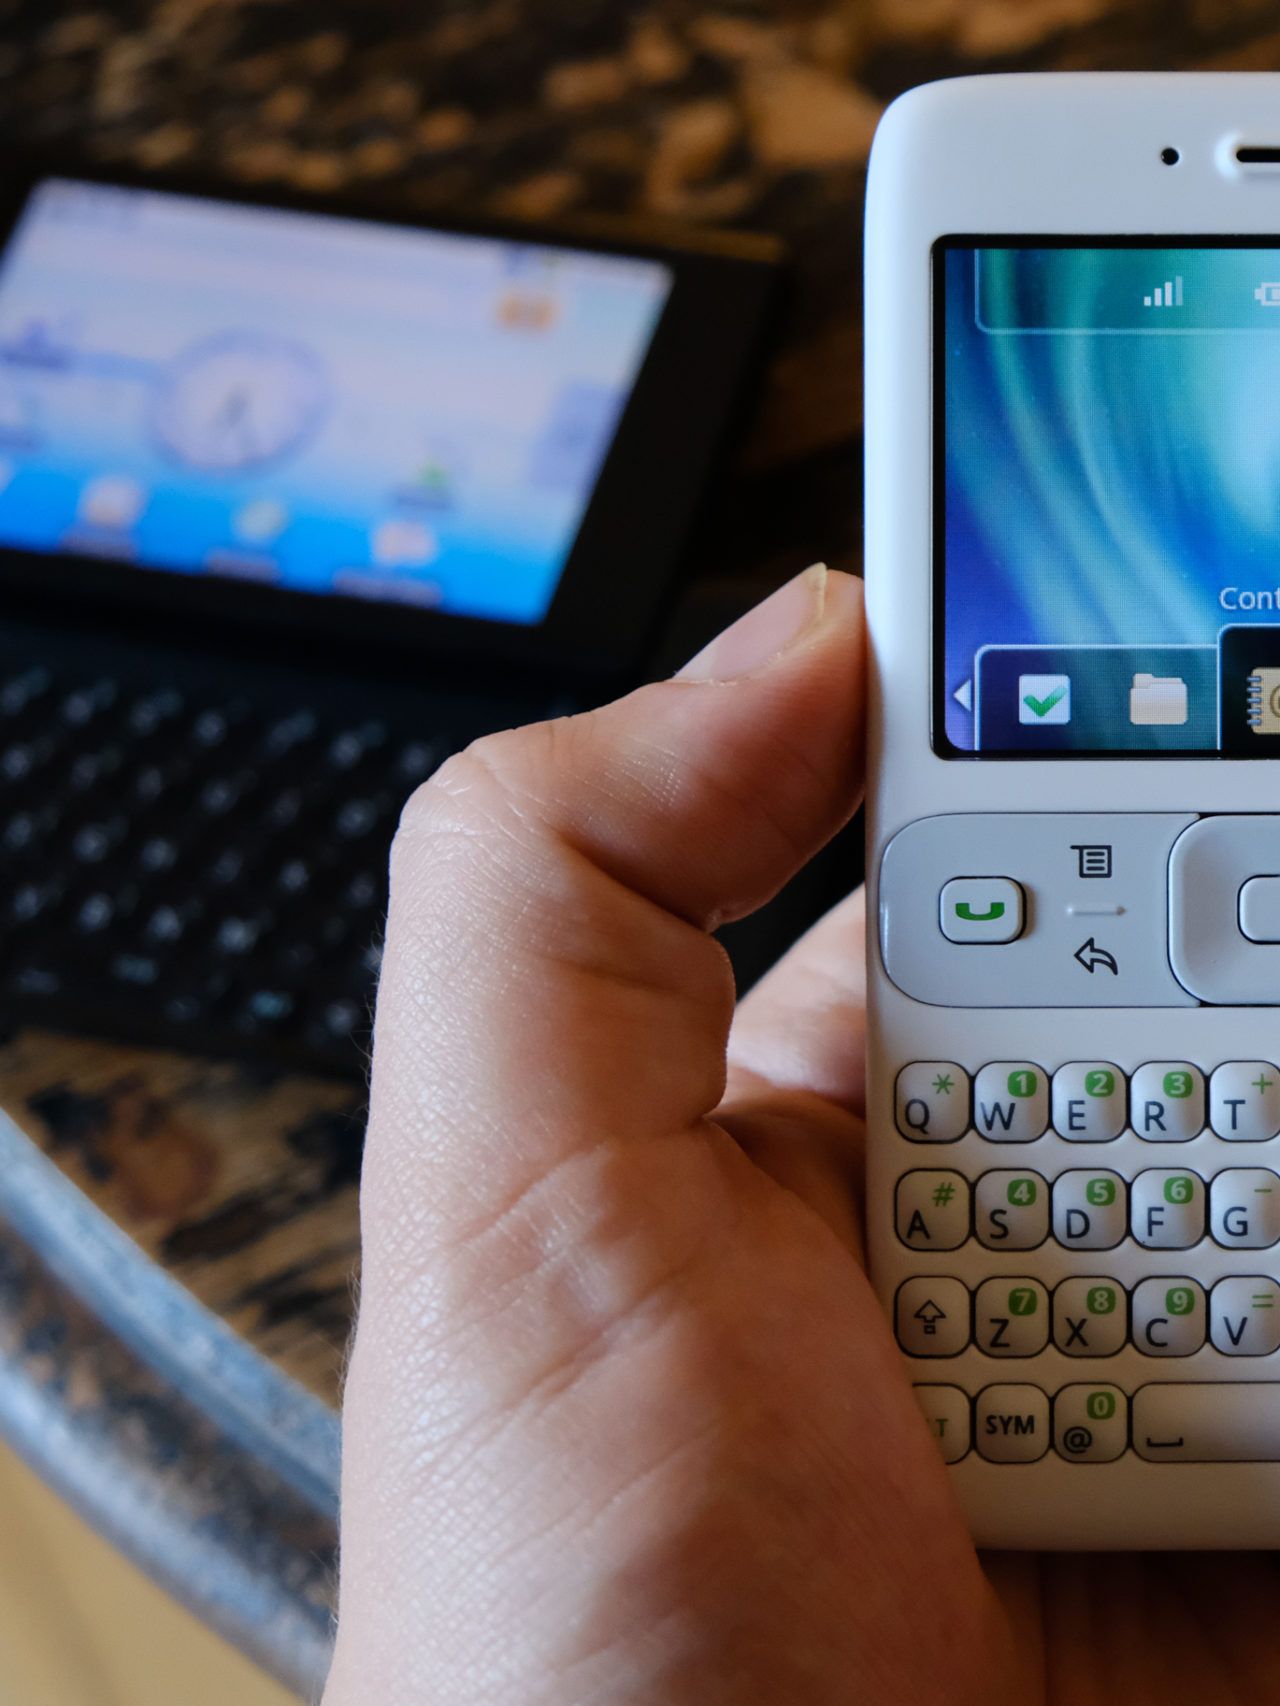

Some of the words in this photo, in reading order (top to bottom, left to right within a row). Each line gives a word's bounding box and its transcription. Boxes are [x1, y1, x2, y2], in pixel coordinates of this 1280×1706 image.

[905, 1099, 930, 1134] Q
[980, 1102, 1016, 1131] W
[1068, 1100, 1086, 1131] E
[1144, 1100, 1166, 1131] R
[1224, 1099, 1245, 1130] T
[932, 1182, 955, 1206] #
[906, 1210, 931, 1239] A
[989, 1209, 1009, 1239] S
[1066, 1209, 1090, 1239] D
[1147, 1207, 1164, 1236] F
[1223, 1206, 1248, 1237] G
[989, 1318, 1010, 1347] Z
[1065, 1318, 1088, 1347] X
[1145, 1318, 1168, 1347] C
[1224, 1317, 1247, 1346] V
[986, 1415, 1035, 1435] SYM
[1063, 1426, 1093, 1454] @
